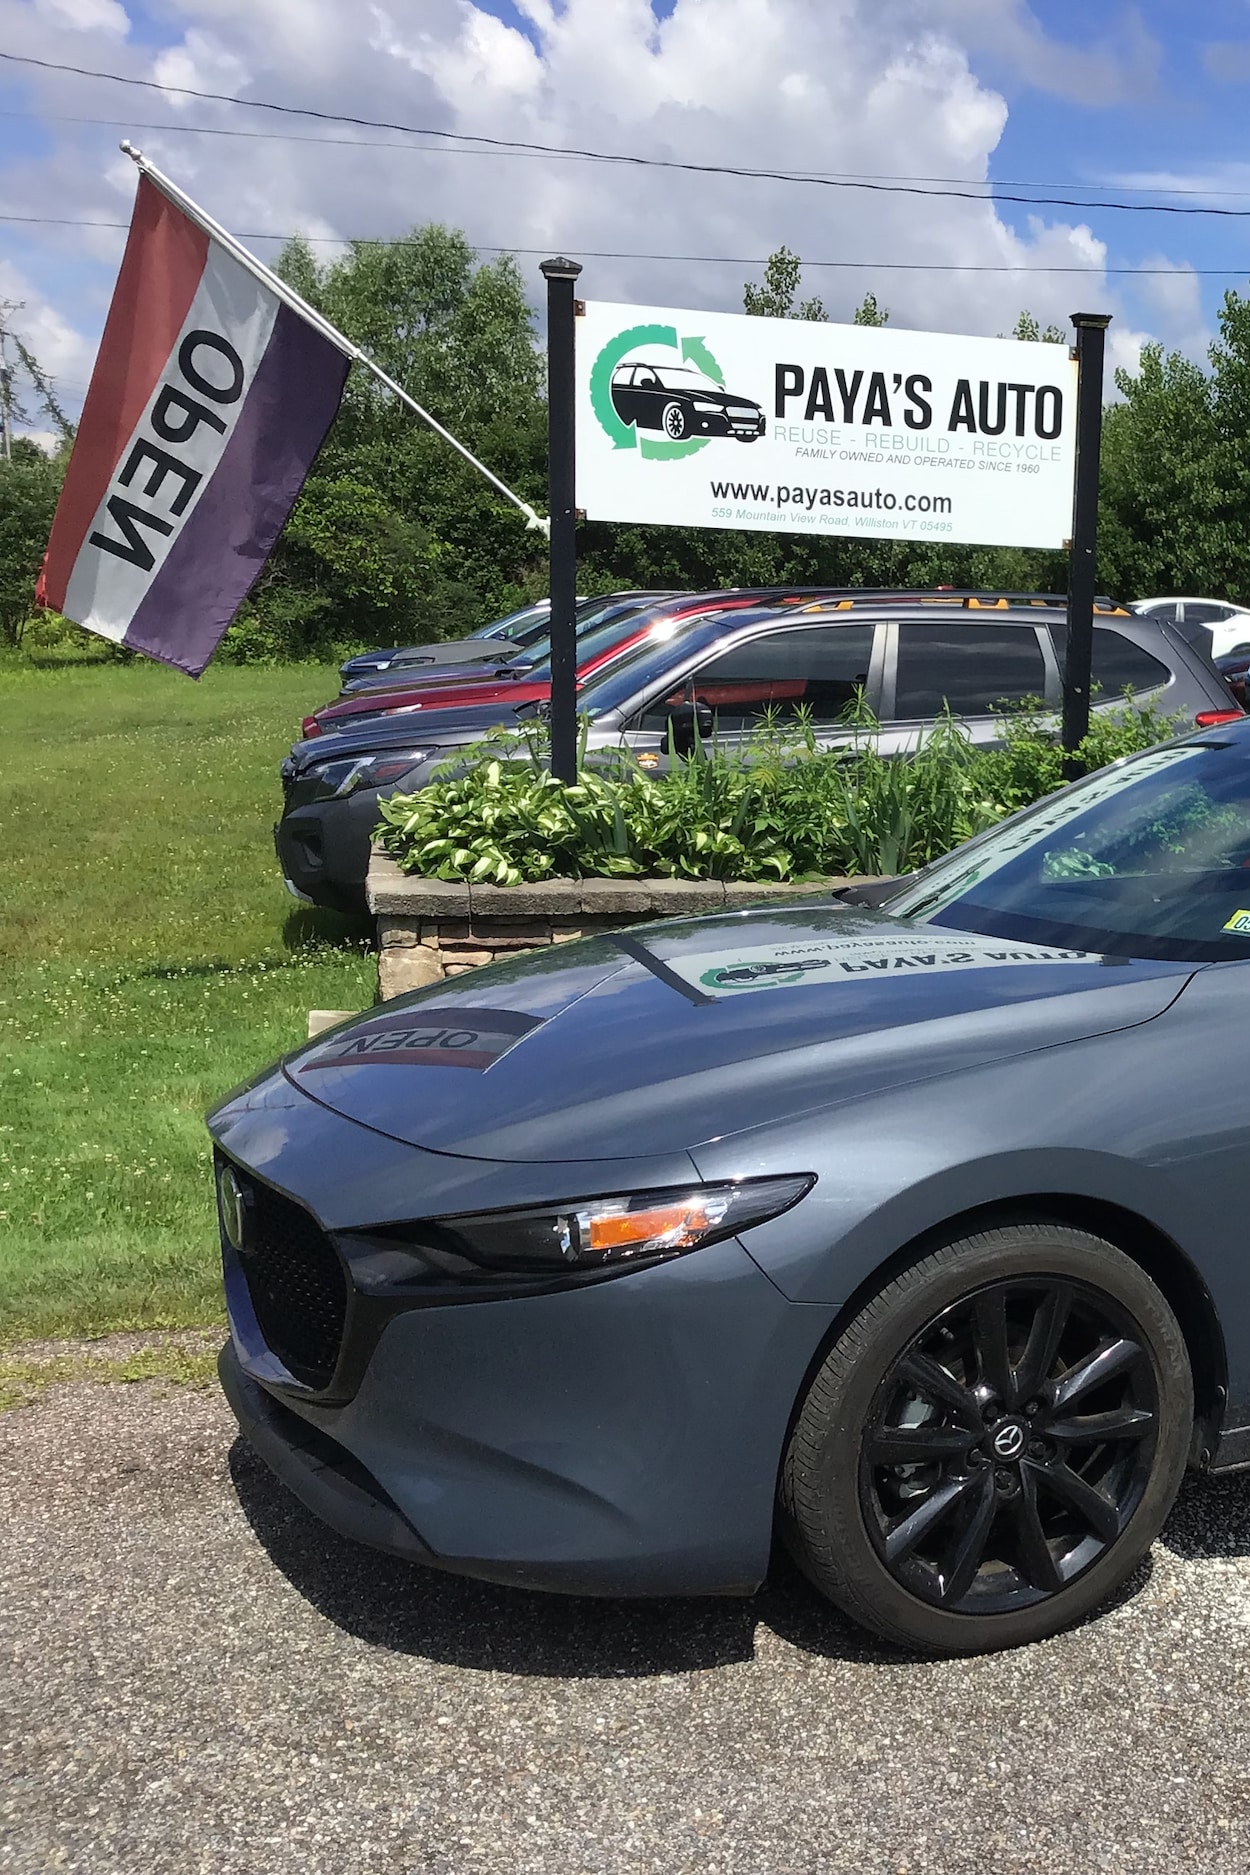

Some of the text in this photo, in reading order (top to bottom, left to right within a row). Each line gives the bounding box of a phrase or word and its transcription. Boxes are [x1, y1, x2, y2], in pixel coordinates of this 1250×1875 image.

[775, 363, 1063, 440] PAYA'S AUTO
[774, 425, 841, 445] REUSE
[865, 432, 950, 453] REBUILD
[973, 440, 1062, 462] RECYCLE
[795, 447, 1040, 474] FAMILY OWNED AND OPERATED SINCE 1960
[710, 481, 952, 514] www.payasauto.com
[711, 507, 733, 518] 559
[735, 509, 786, 521] Mountain
[790, 512, 816, 523] View
[855, 517, 899, 529] Williston
[902, 520, 918, 530] VT
[920, 520, 953, 532] 05495
[338, 1030, 478, 1056] OPEN
